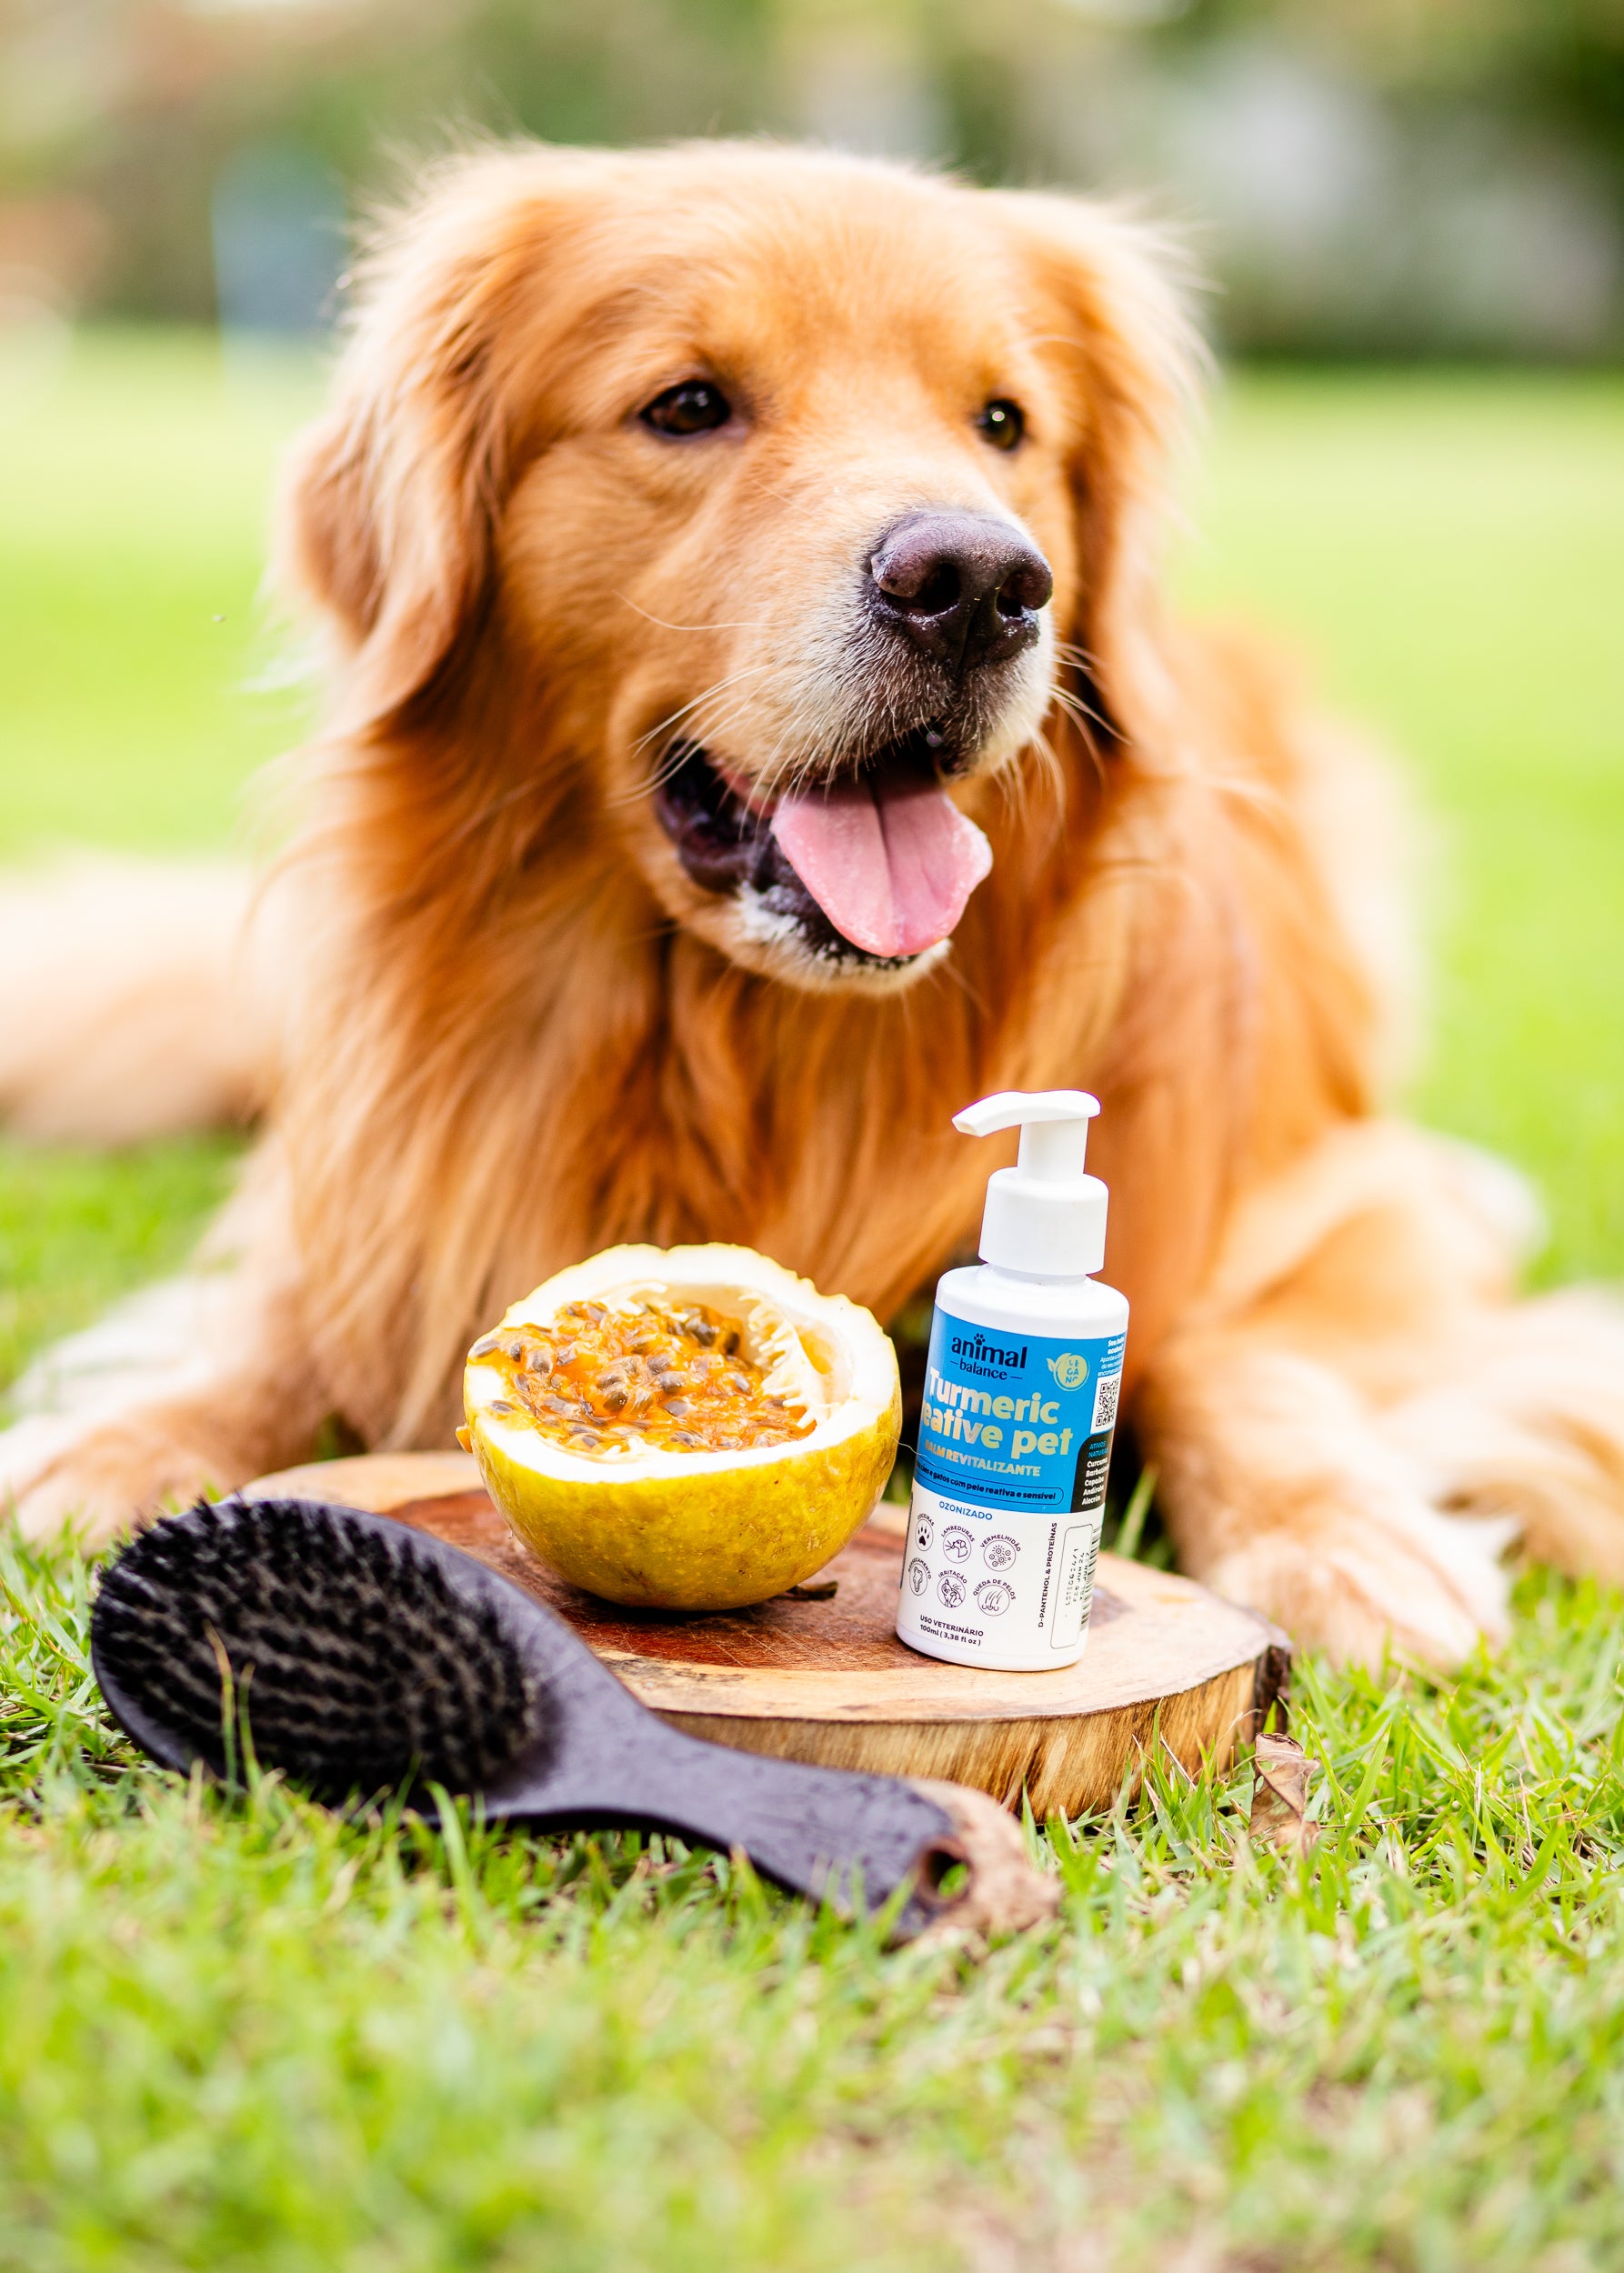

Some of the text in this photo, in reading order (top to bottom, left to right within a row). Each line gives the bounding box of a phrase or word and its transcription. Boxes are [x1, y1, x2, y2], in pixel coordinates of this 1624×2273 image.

[951, 1333, 1028, 1369] animal
[959, 1360, 1007, 1381] balance
[929, 1367, 1061, 1425] Turmeric
[1011, 1427, 1074, 1460] pet
[946, 1448, 1042, 1477] REVITALIZANTE
[933, 1471, 950, 1483] gatos
[950, 1478, 966, 1488] com
[967, 1482, 985, 1492] pele
[985, 1486, 1016, 1497] reativa
[1023, 1491, 1057, 1500] sensível
[938, 1500, 993, 1521] OZONIZADO
[941, 1526, 976, 1543] LAMBEDURAS
[980, 1534, 1021, 1552] VERMELHIDÃO
[938, 1569, 967, 1584] IRRITAÇÃO
[1038, 1576, 1050, 1627] D-PANTENOL
[1046, 1522, 1058, 1567] PROTEÍNAS
[973, 1579, 991, 1597] QUEDA
[1002, 1582, 1017, 1600] PELOS
[919, 1614, 984, 1637] USO VETERINÁRIO
[920, 1624, 939, 1637] 100ml
[943, 1632, 959, 1641] 3,38
